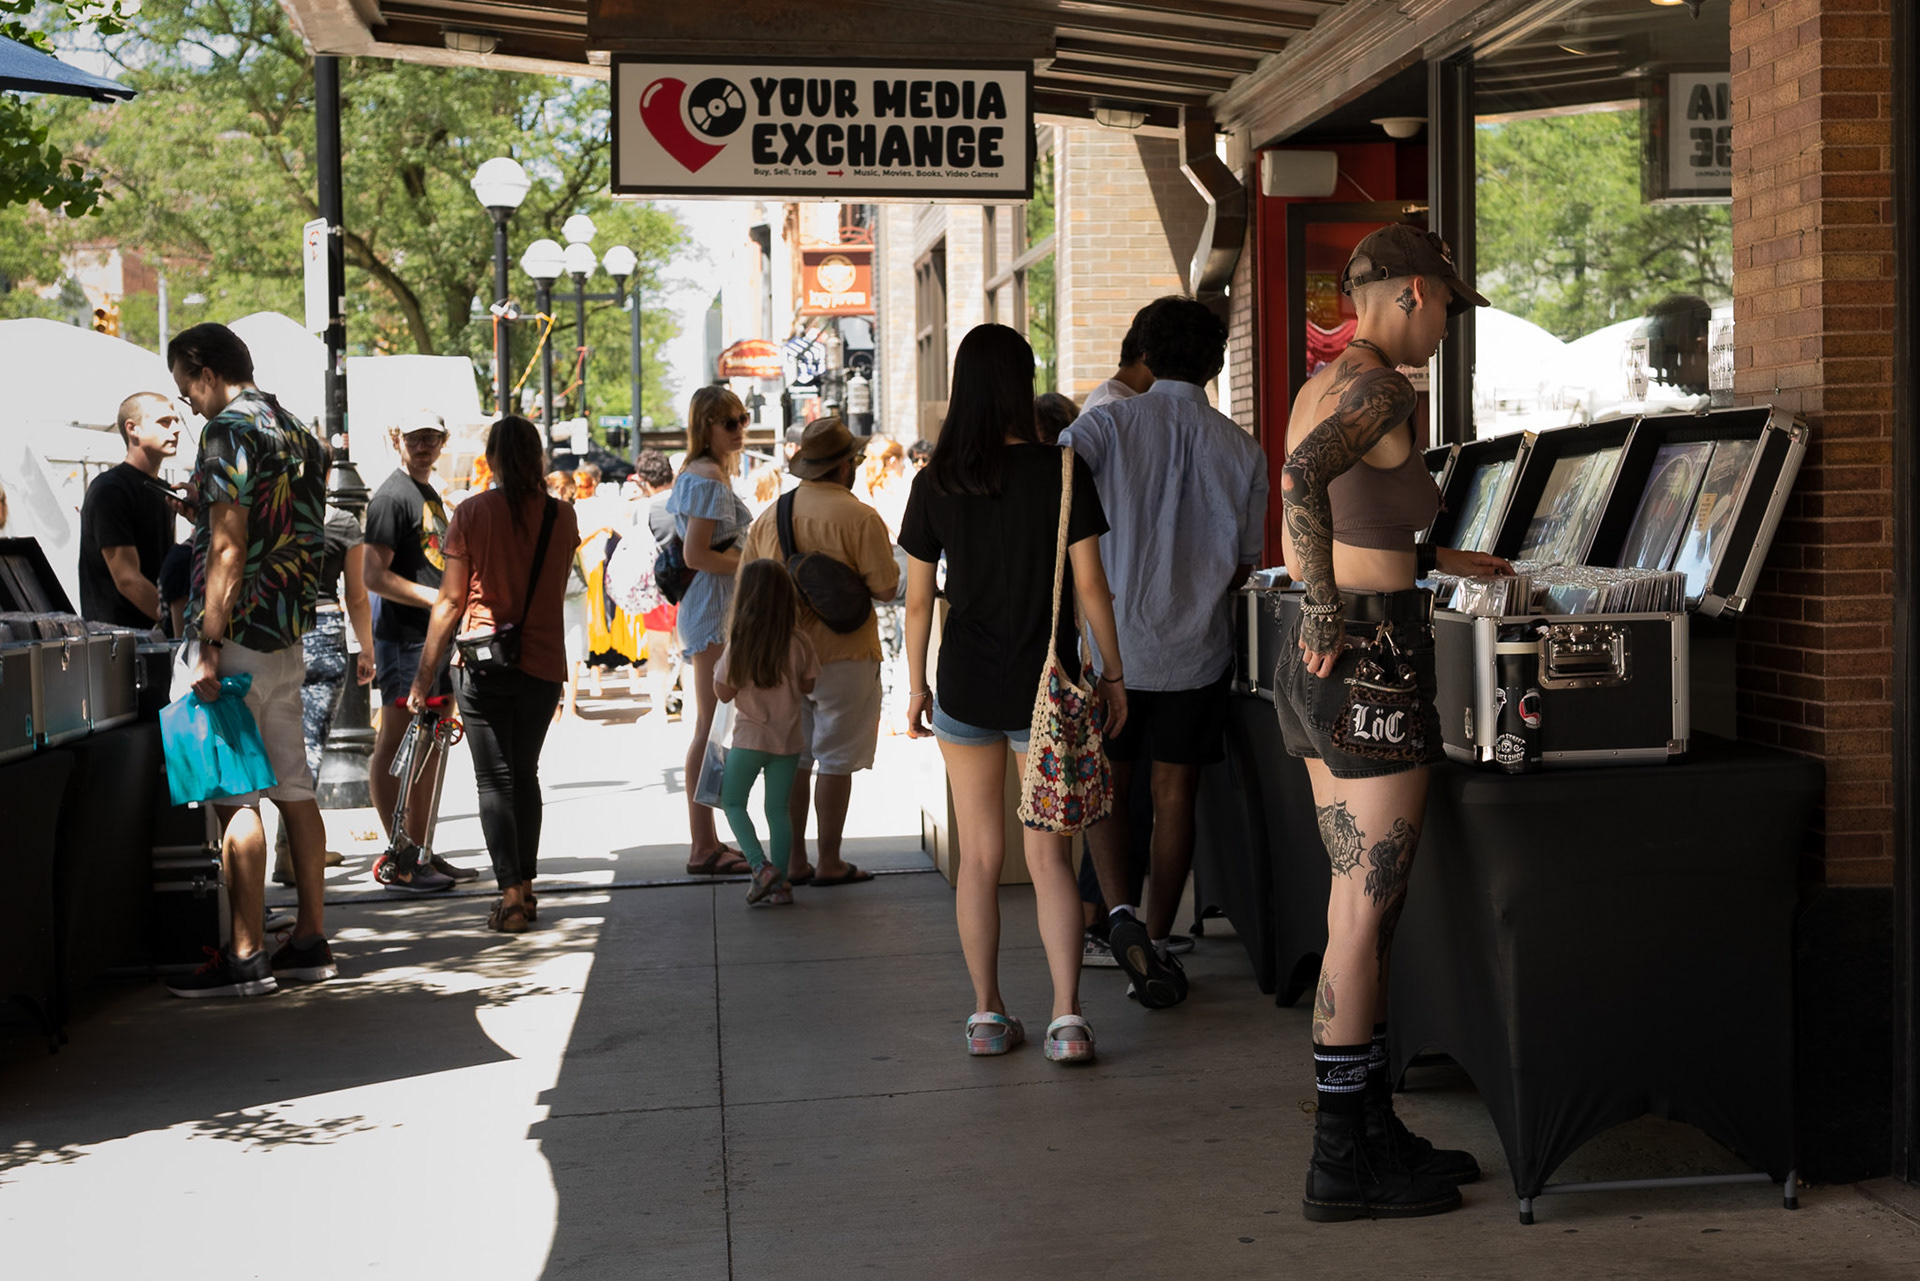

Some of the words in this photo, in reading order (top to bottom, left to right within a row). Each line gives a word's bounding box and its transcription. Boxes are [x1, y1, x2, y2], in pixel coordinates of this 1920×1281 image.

[750, 77, 859, 119] YOUR
[873, 80, 1007, 120] MEDIA
[752, 123, 1005, 168] EXCHANGE
[753, 168, 771, 177] Buy,
[774, 168, 791, 177] Sell,
[793, 168, 817, 176] Trade
[853, 169, 880, 177] Music,
[882, 169, 914, 178] Movies,
[916, 170, 943, 178] Books,
[945, 170, 969, 178] Video
[971, 170, 999, 178] Games
